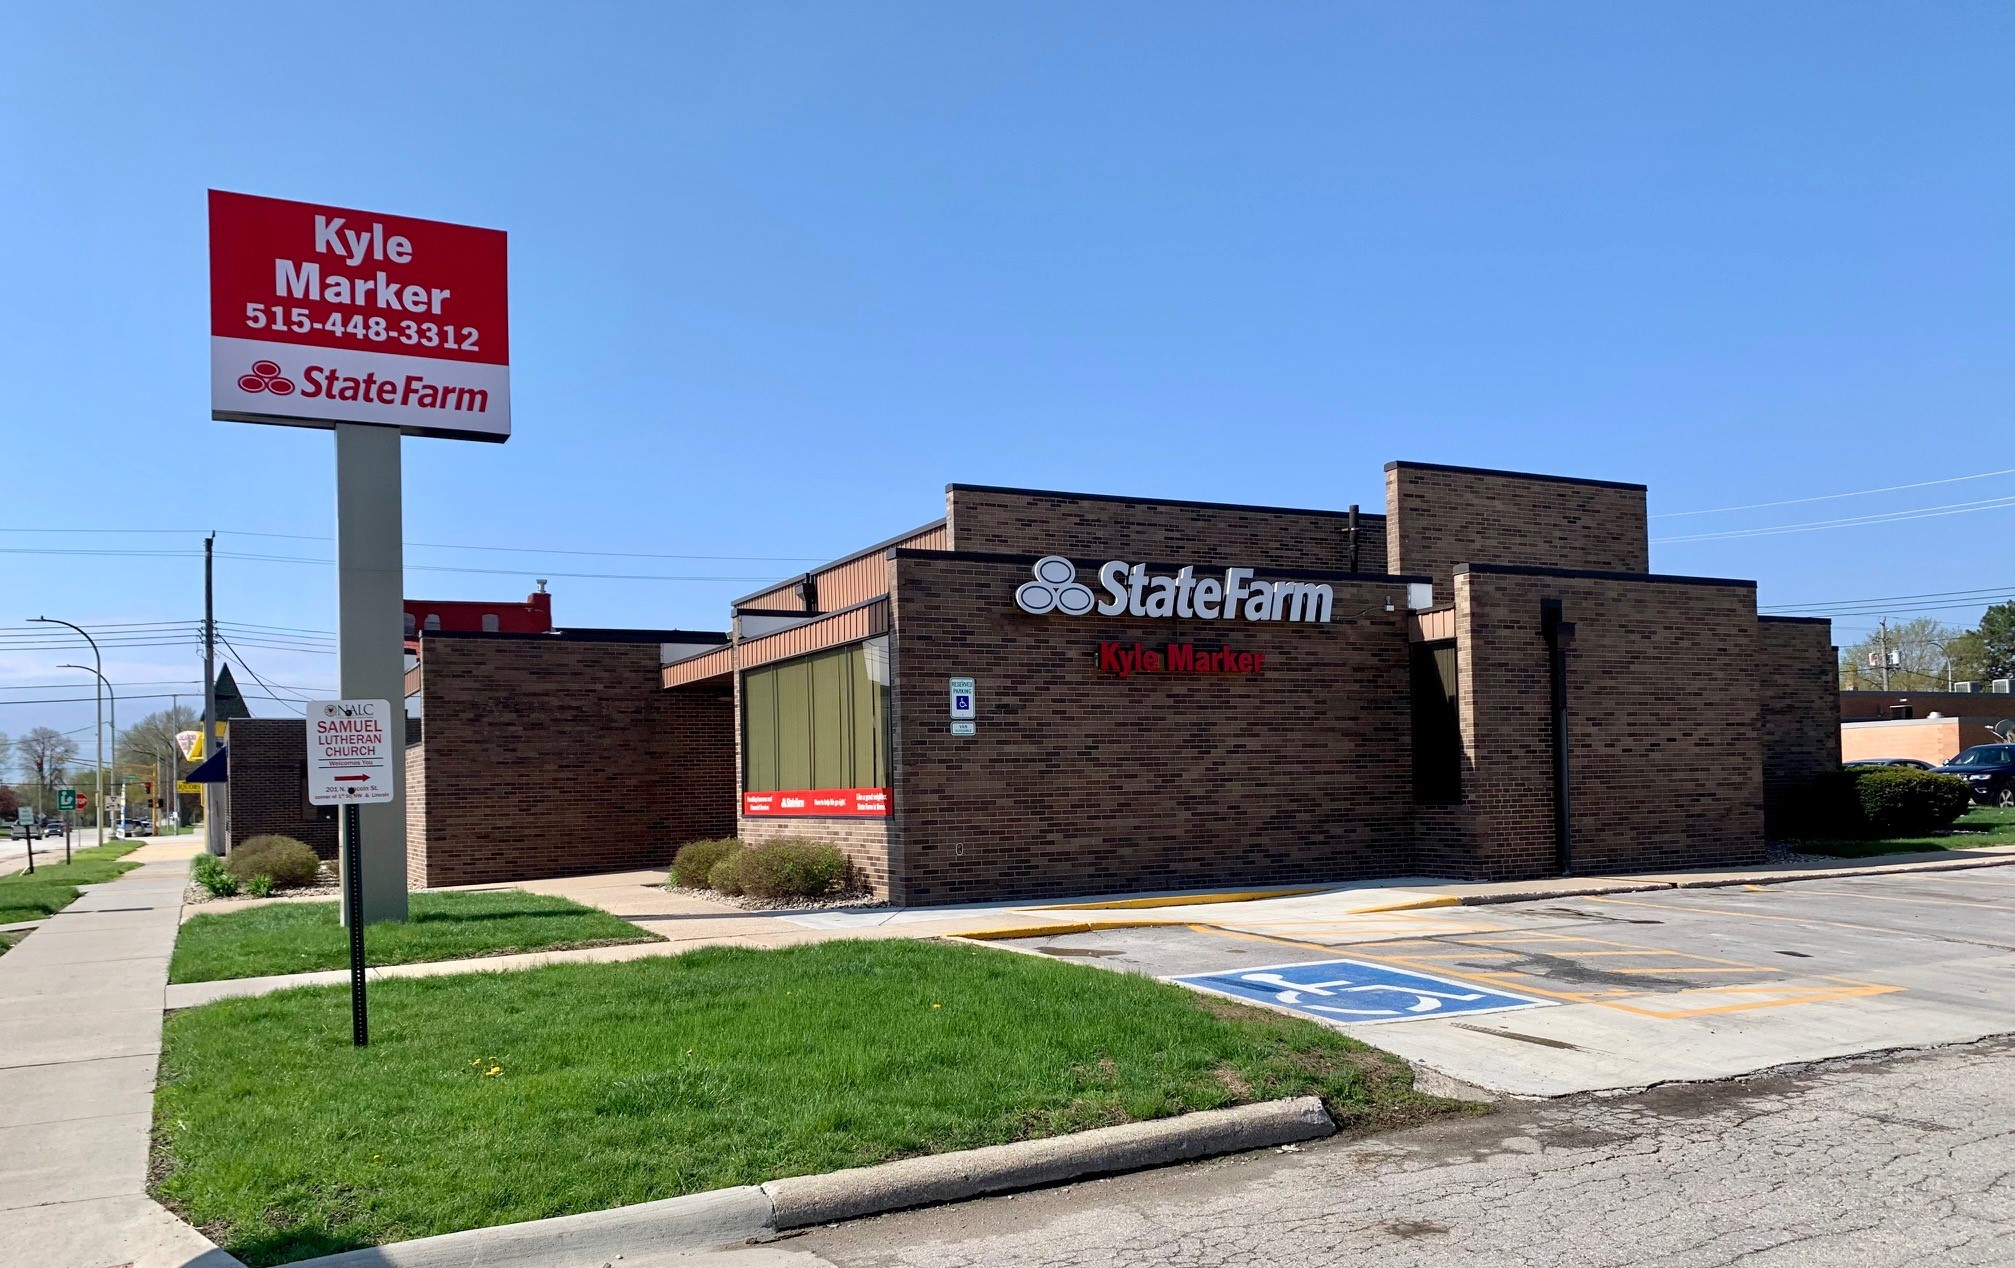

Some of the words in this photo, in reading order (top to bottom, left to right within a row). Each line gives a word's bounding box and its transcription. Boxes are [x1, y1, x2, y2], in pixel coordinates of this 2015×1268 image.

[314, 214, 413, 267] Kyle
[275, 258, 451, 315] Marker
[245, 302, 480, 352] 515-448-3312
[1099, 641, 1159, 679] Kyle
[1167, 643, 1266, 674] Marker
[337, 703, 374, 716] NALC
[317, 720, 382, 733] SAMUEL
[318, 734, 382, 745] LUTHERAN
[325, 745, 376, 757] CHURCH
